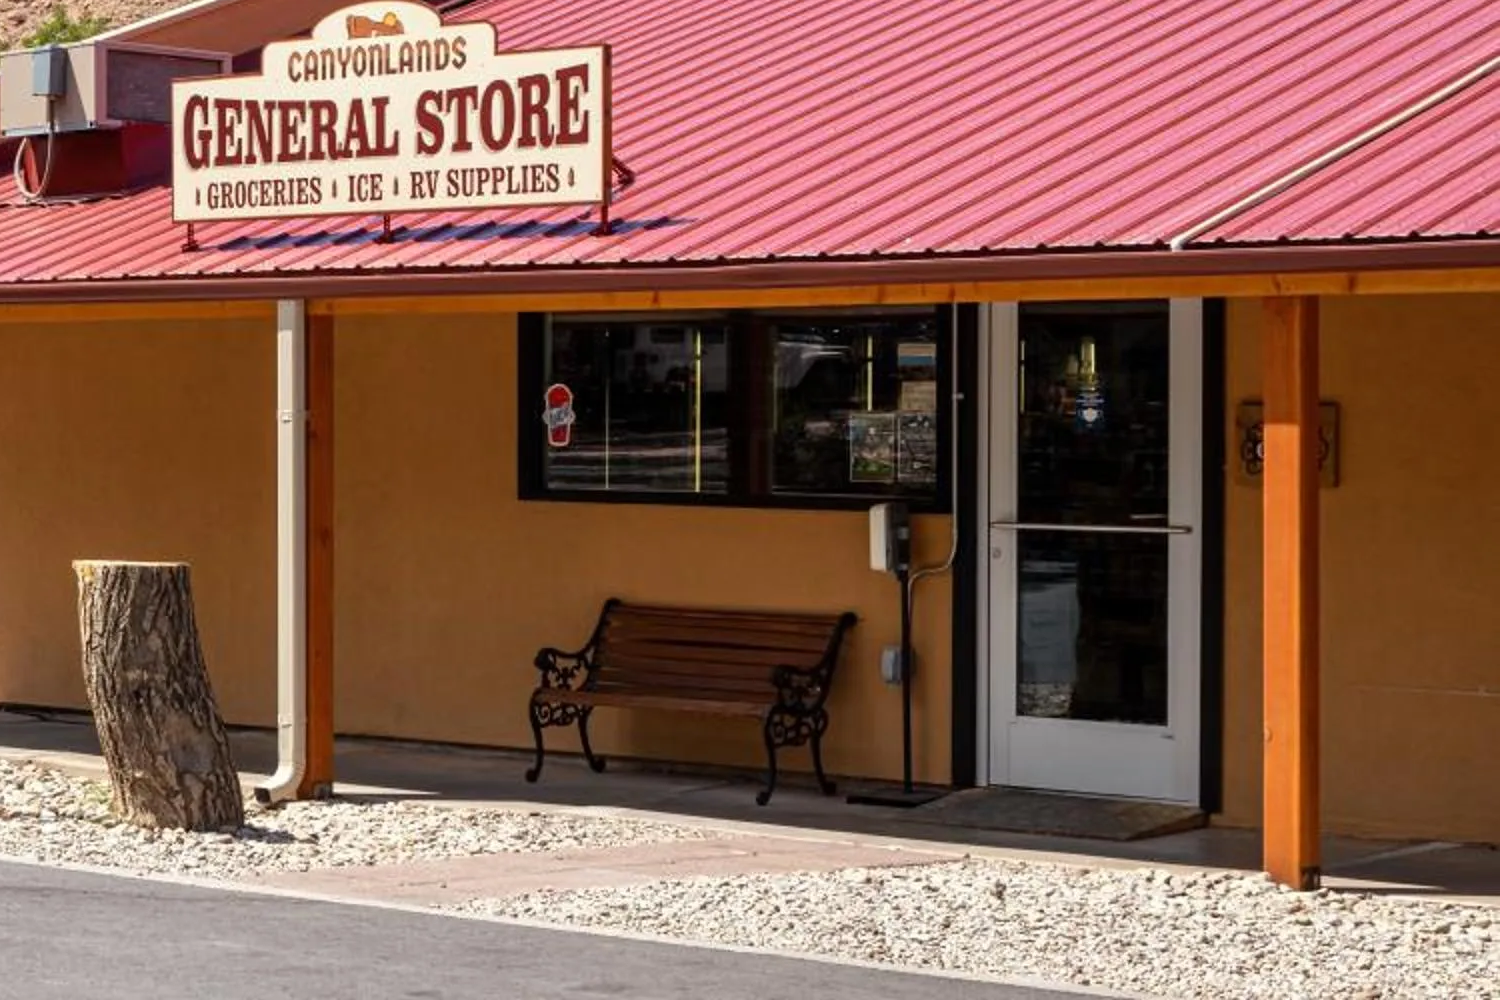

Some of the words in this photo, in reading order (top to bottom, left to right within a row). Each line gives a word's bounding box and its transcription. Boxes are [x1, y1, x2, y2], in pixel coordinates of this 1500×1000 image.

[287, 36, 467, 82] CANYONLANDS
[183, 95, 399, 168] GENERAL
[416, 64, 589, 155] STORE
[207, 177, 322, 209] GROCERIES
[348, 174, 383, 202] ICE
[410, 169, 440, 199] RV
[447, 163, 560, 197] SUPPLIES
